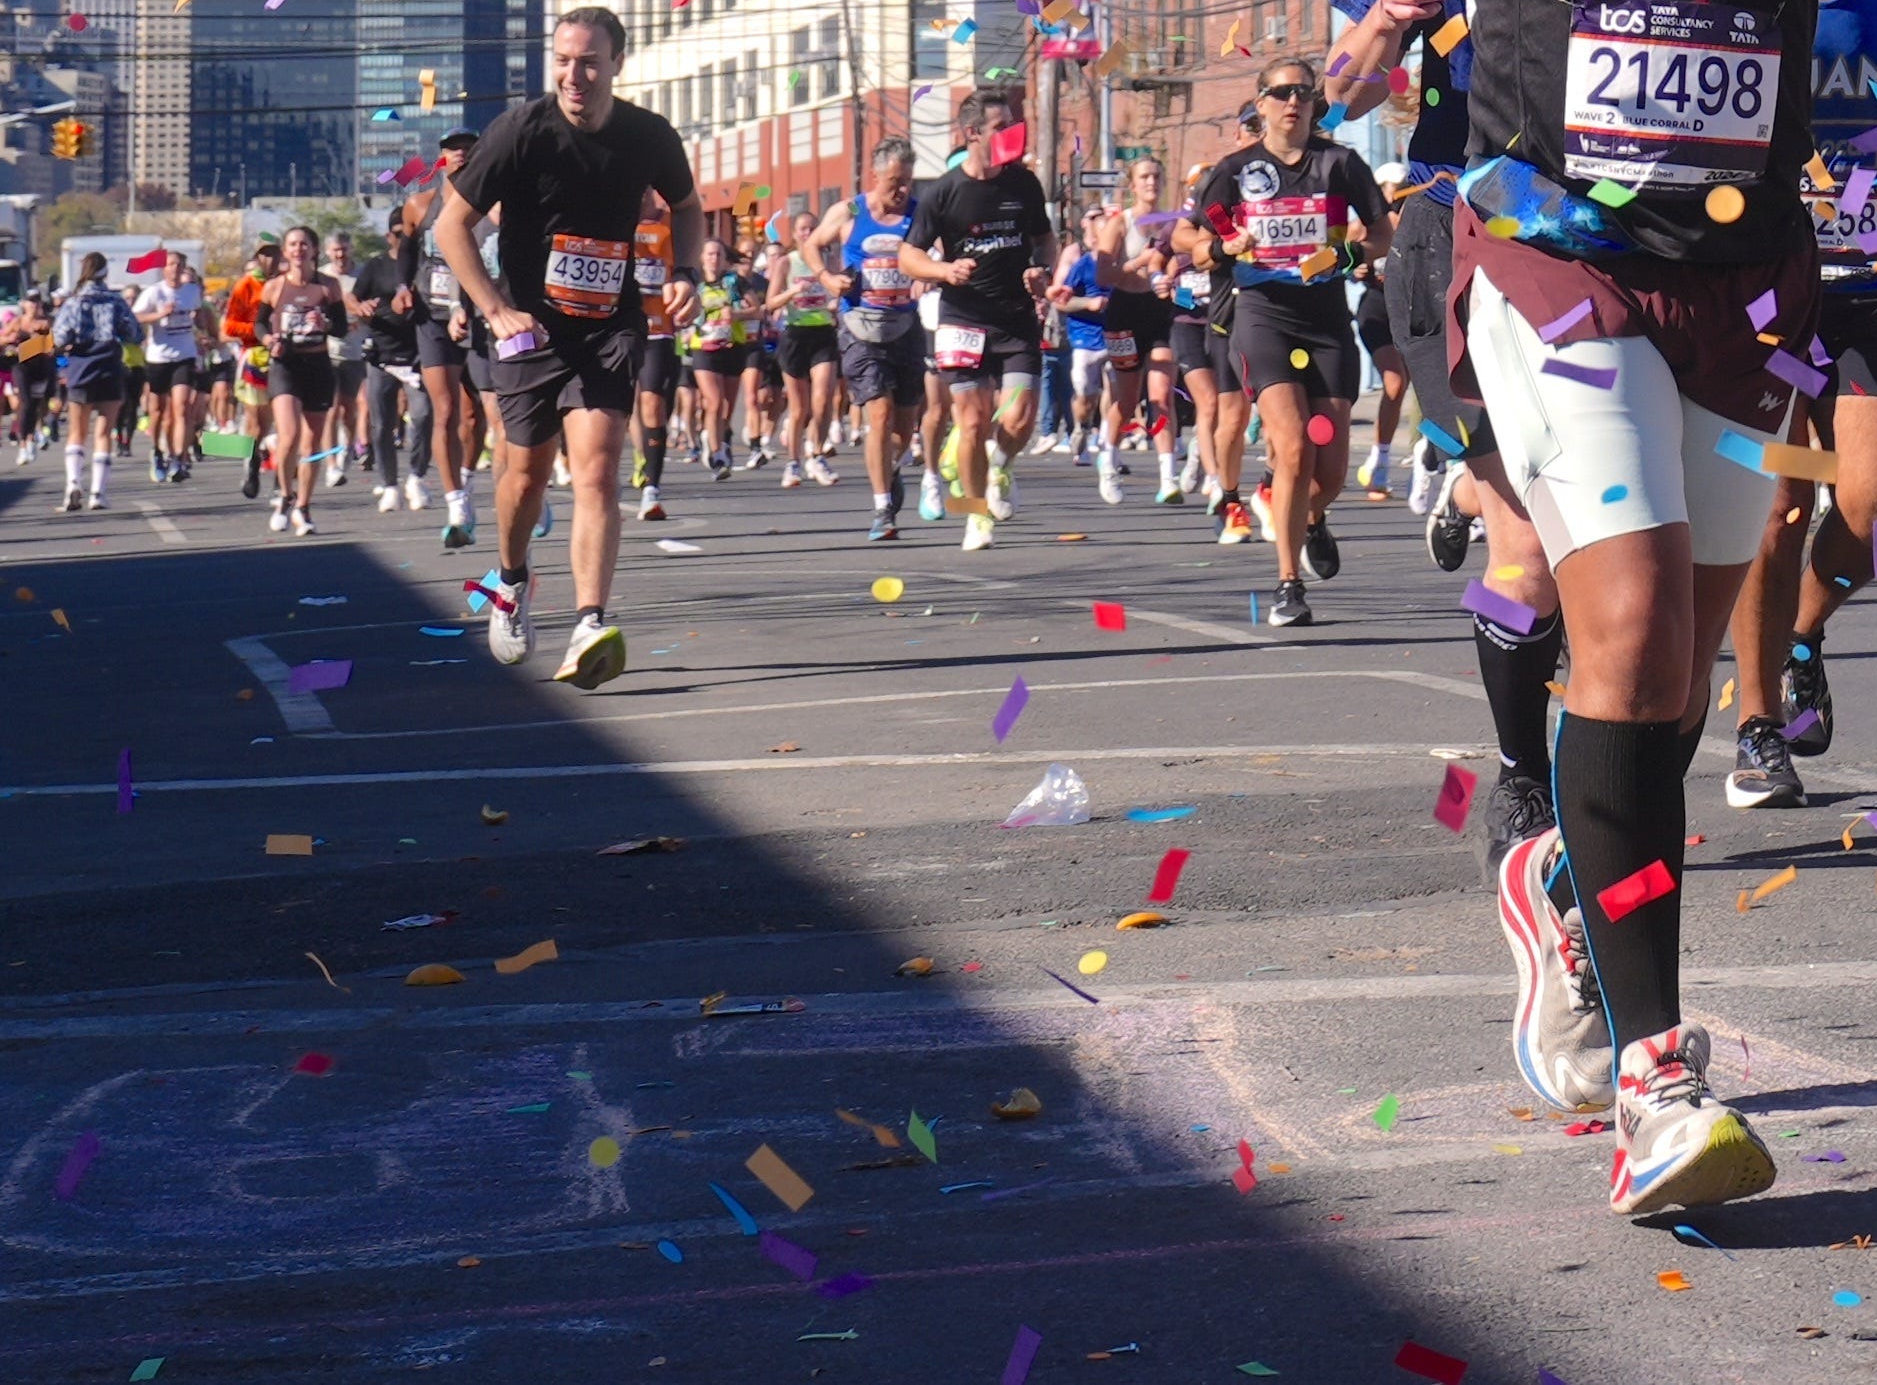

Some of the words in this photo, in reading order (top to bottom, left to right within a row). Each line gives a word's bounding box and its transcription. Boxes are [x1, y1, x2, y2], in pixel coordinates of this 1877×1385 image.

[1600, 2, 1646, 34] tcs
[1587, 46, 1764, 119] 21498
[1574, 110, 1602, 122] WAVE
[1606, 112, 1616, 125] 2
[1623, 116, 1648, 126] BLUE
[1650, 117, 1690, 130] CORRAL
[1693, 119, 1704, 132] D
[1256, 217, 1318, 239] 16514
[553, 255, 623, 286] 43954
